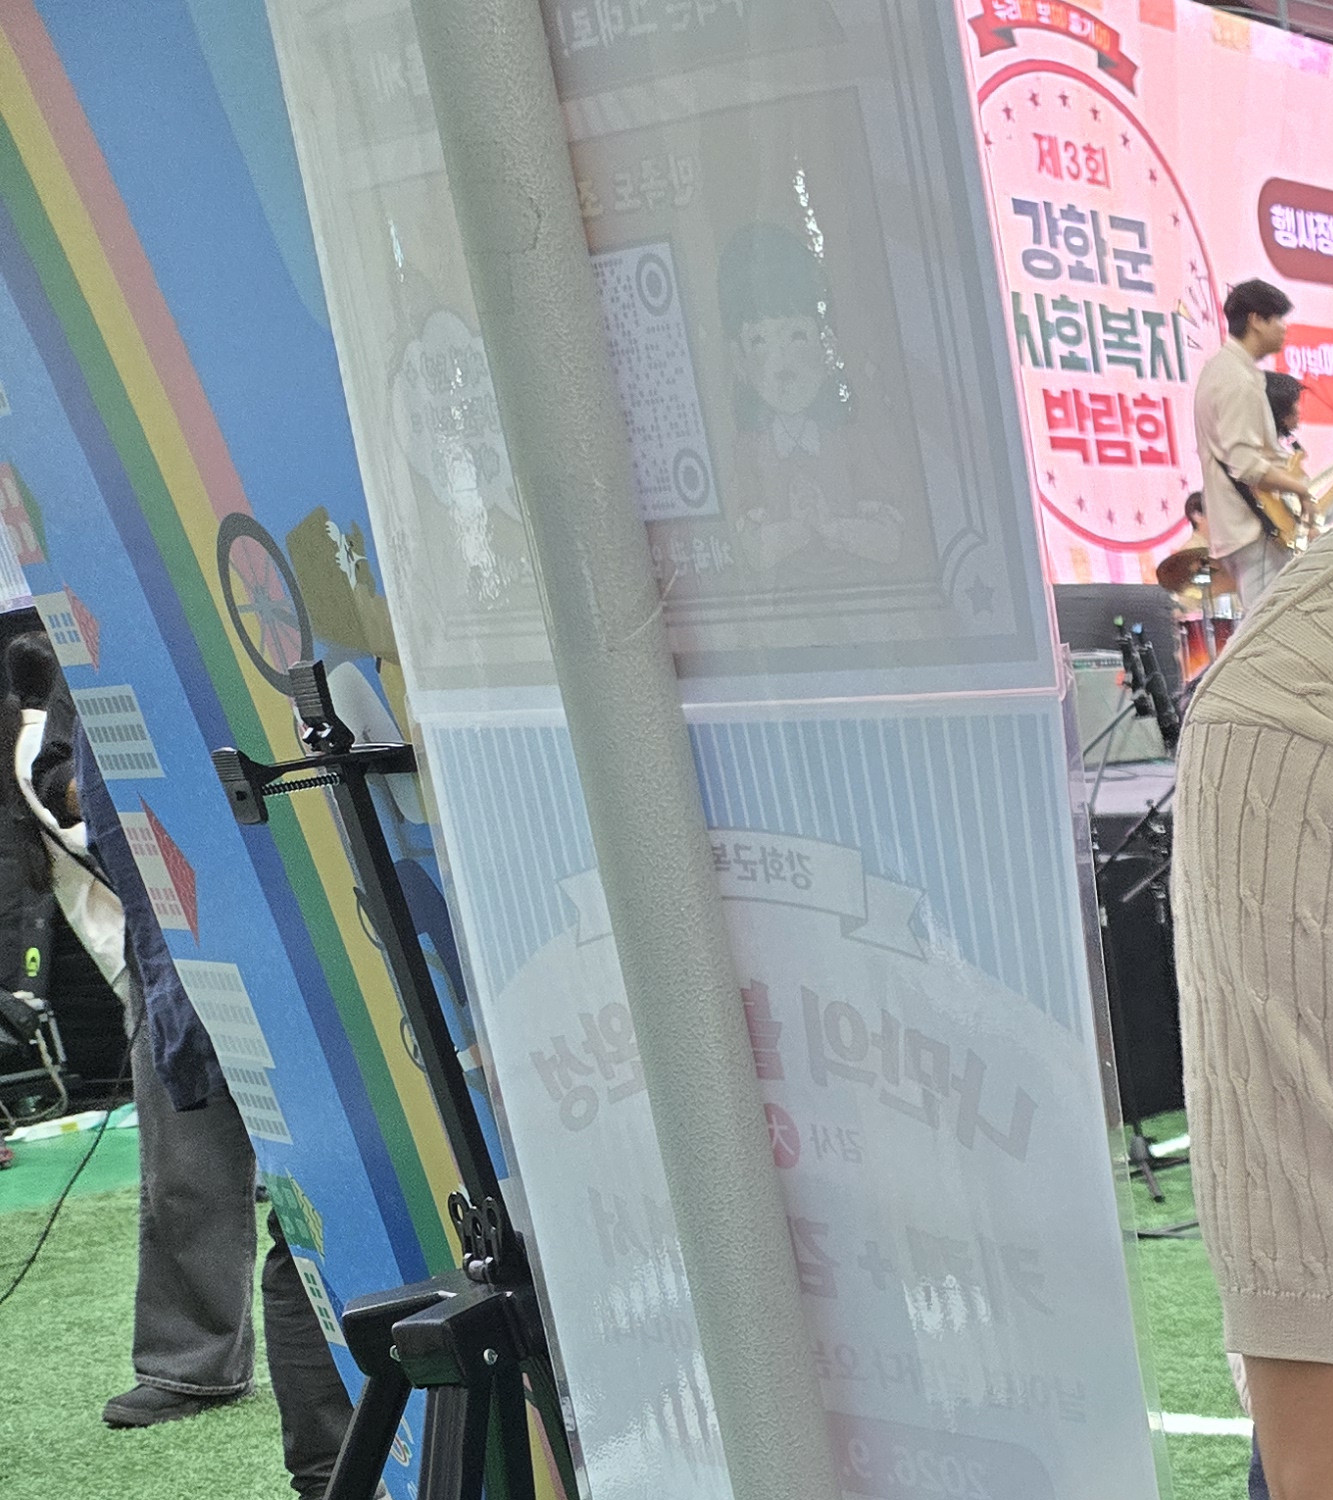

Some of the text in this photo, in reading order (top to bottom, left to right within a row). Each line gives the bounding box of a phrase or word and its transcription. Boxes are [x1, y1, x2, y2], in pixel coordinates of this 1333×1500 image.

[1033, 132, 1110, 189] 제3회
[1011, 197, 1155, 293] 강화군
[1012, 291, 1188, 382] 사회복지
[1042, 388, 1181, 466] 박람회
